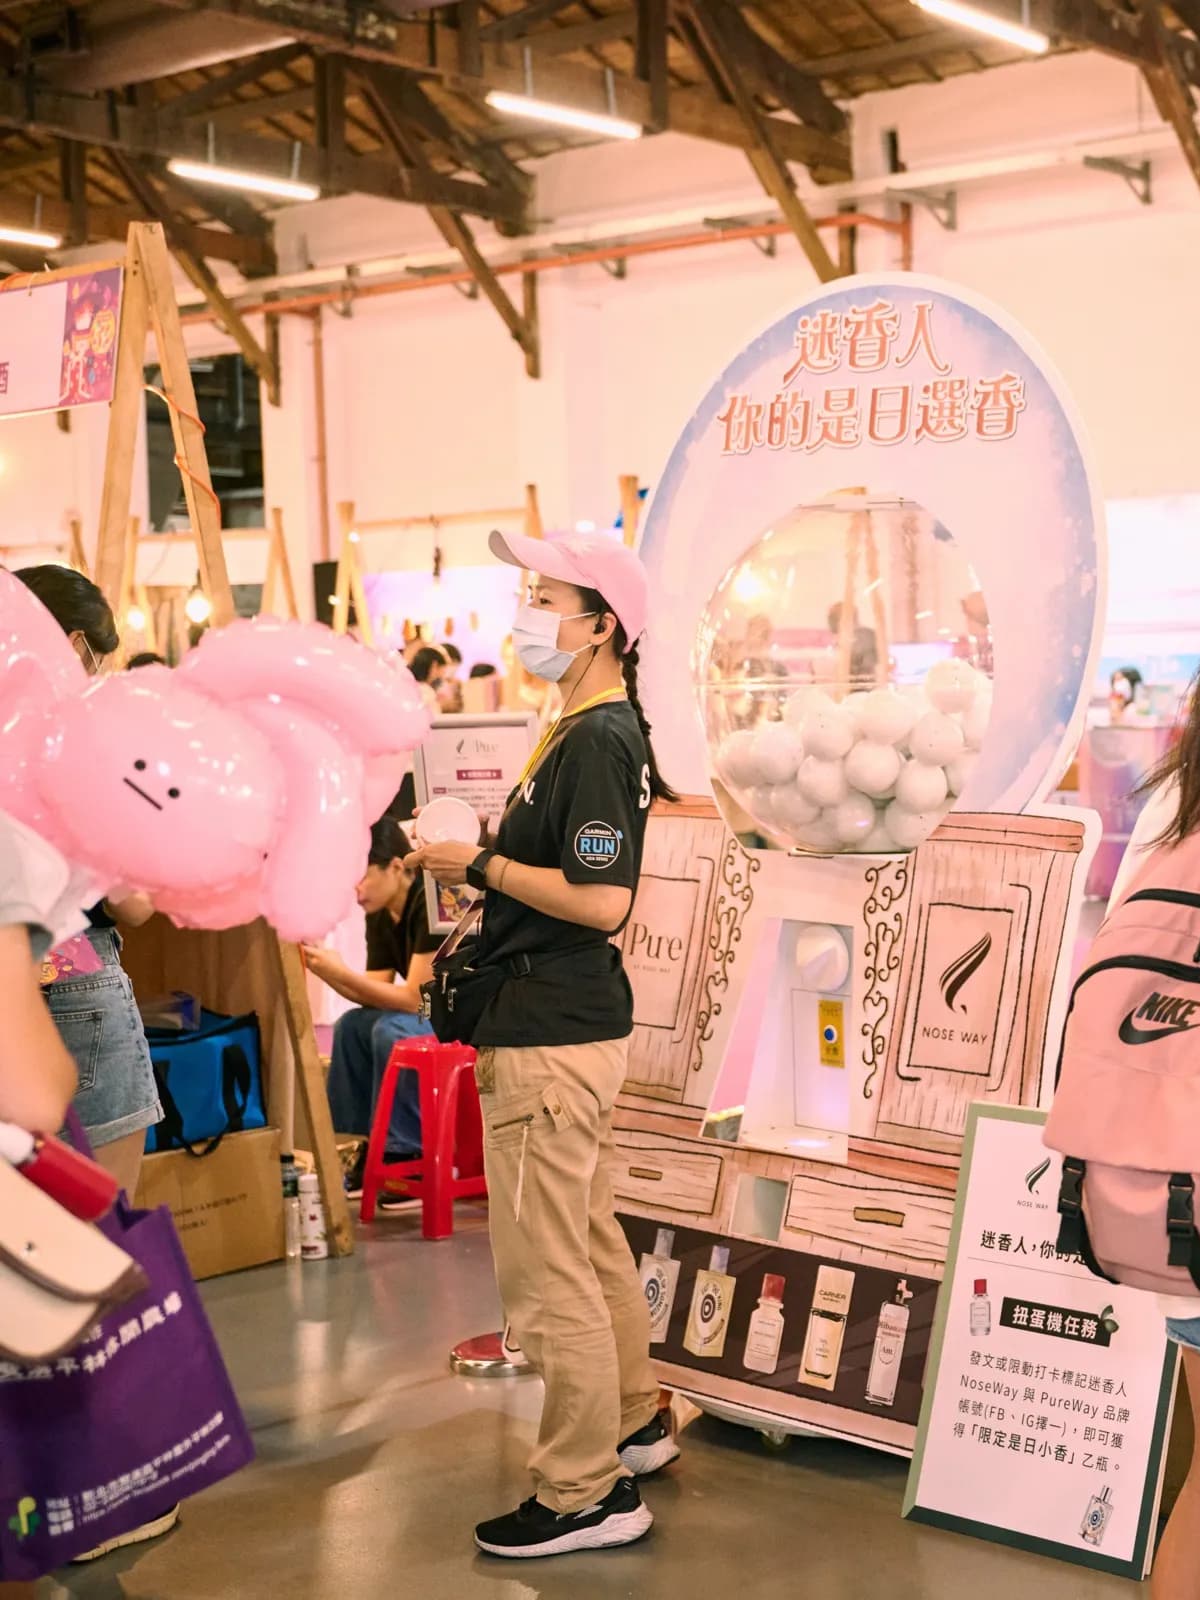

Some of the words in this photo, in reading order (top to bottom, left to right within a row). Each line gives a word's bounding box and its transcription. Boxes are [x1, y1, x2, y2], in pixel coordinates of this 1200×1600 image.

[783, 298, 952, 387] 迷香人
[717, 372, 1026, 456] 你的是日選香
[580, 837, 615, 854] RUN
[629, 923, 683, 961] Pure
[921, 1026, 956, 1042] NOSE
[959, 1031, 989, 1046] WAY
[1012, 1304, 1099, 1340] 扭蛋機任務
[969, 1350, 1128, 1399] 發文或限動打卡標記迷香人
[960, 1374, 1019, 1401] NoseWay
[1023, 1387, 1036, 1402] 與
[1040, 1391, 1099, 1419] PureWay
[1103, 1404, 1131, 1425] 品牌
